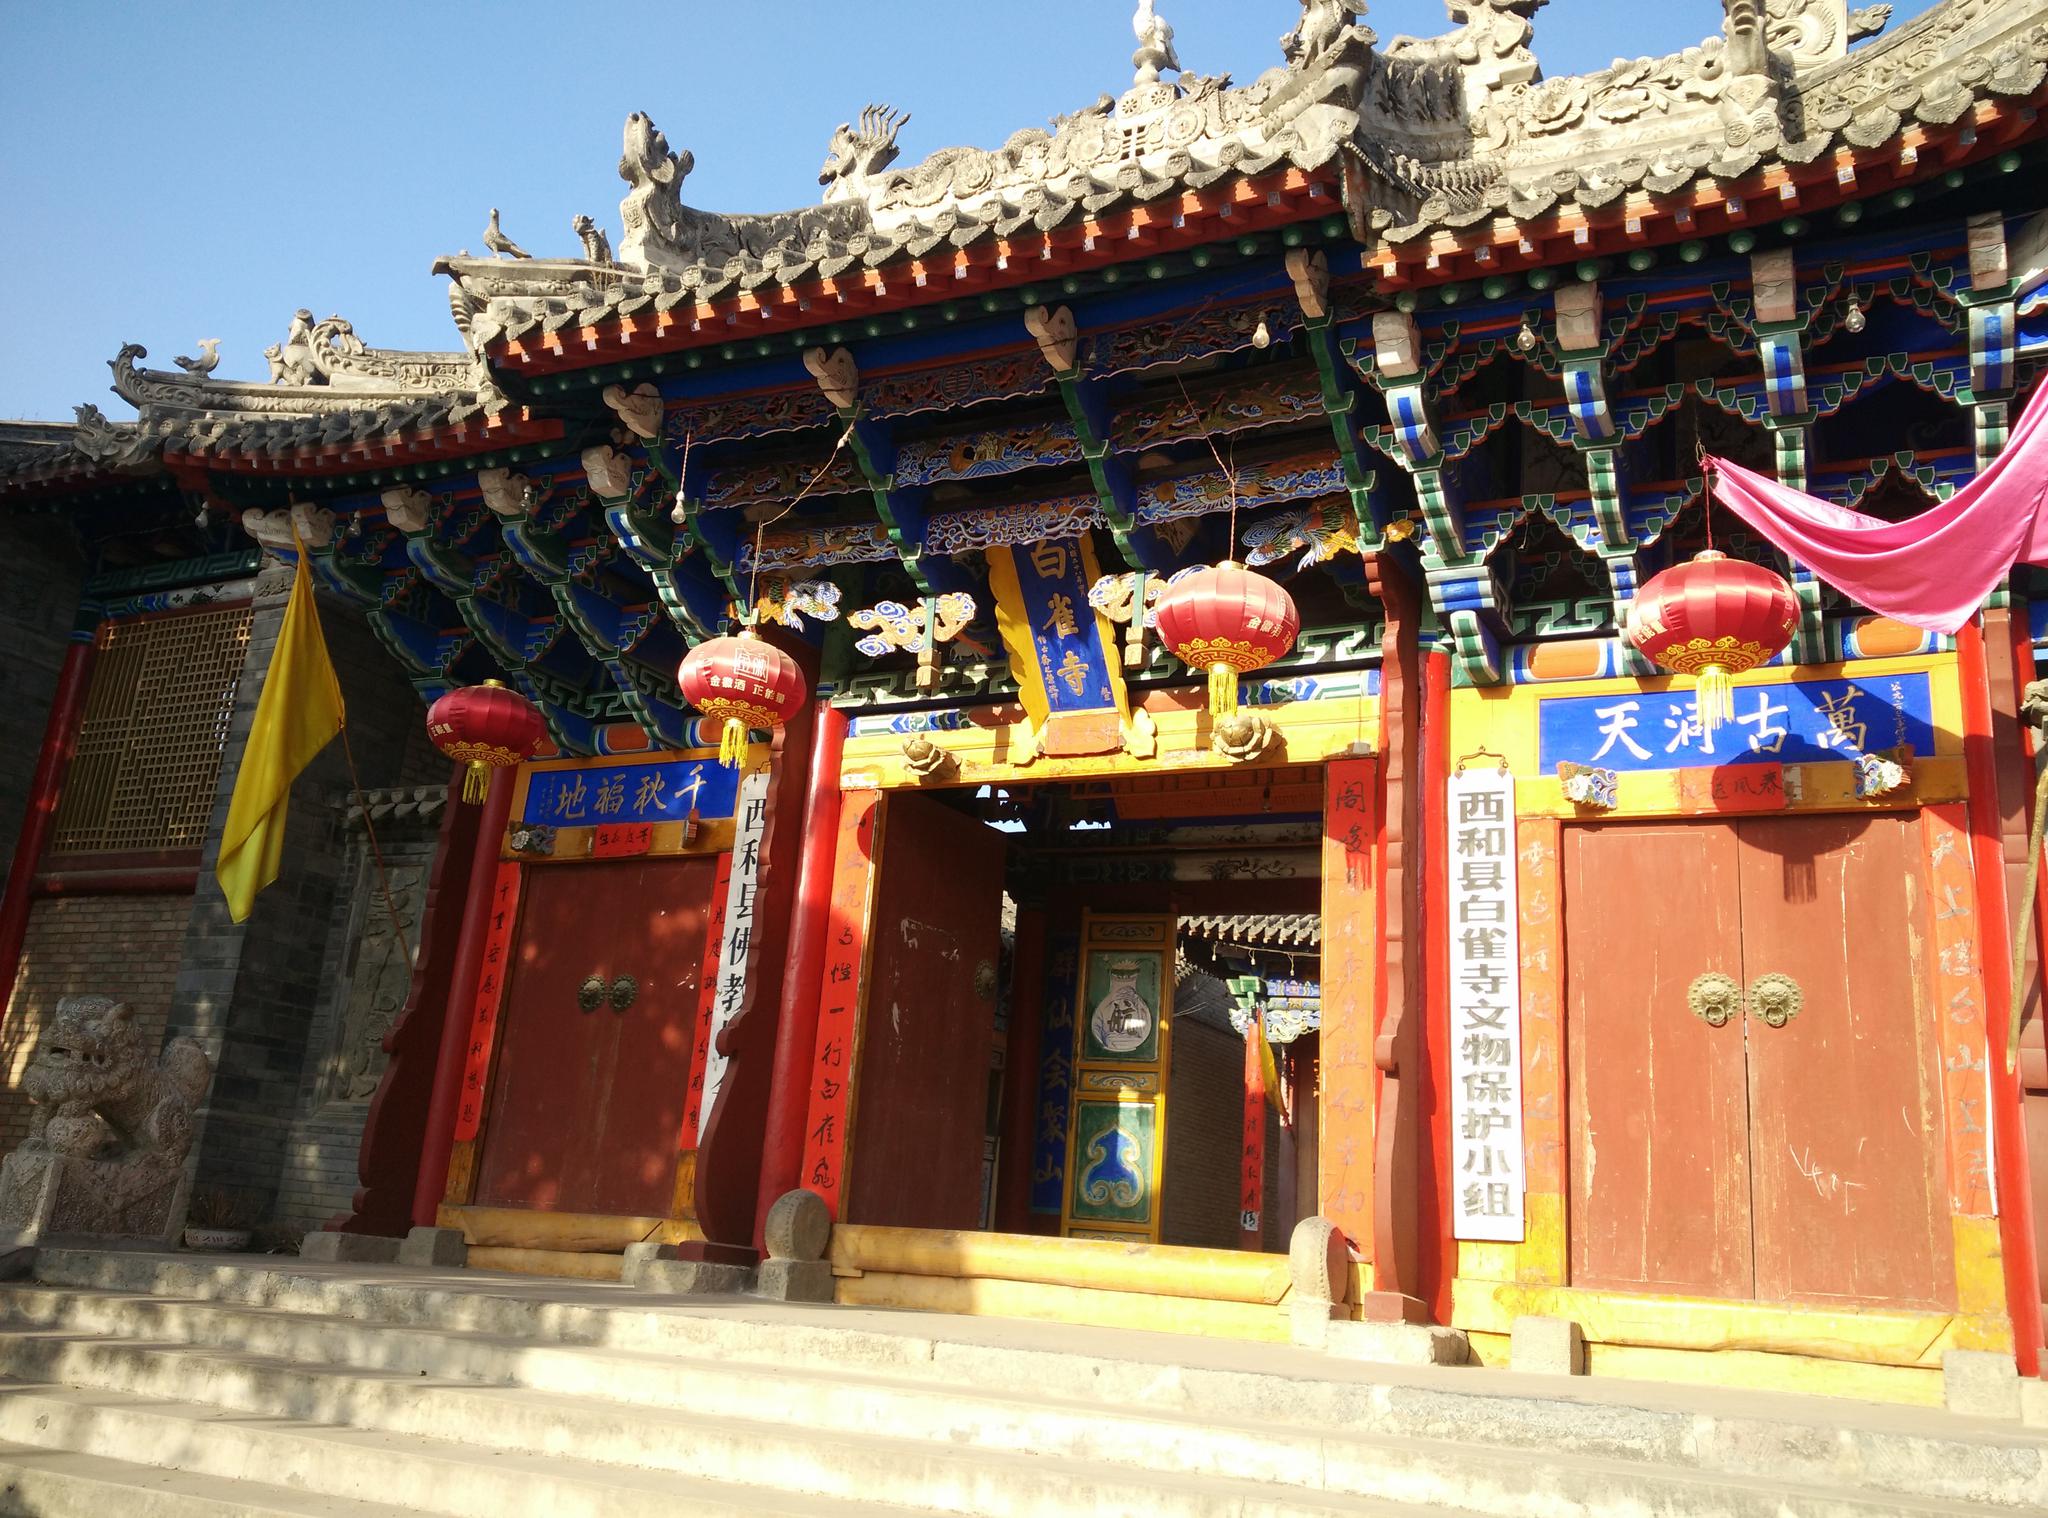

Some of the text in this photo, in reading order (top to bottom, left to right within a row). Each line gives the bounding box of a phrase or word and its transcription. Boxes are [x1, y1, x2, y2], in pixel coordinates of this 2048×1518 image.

[1030, 540, 1089, 697] 白雀寺
[1457, 790, 1515, 1217] 西和县白雀寺文物保护小组
